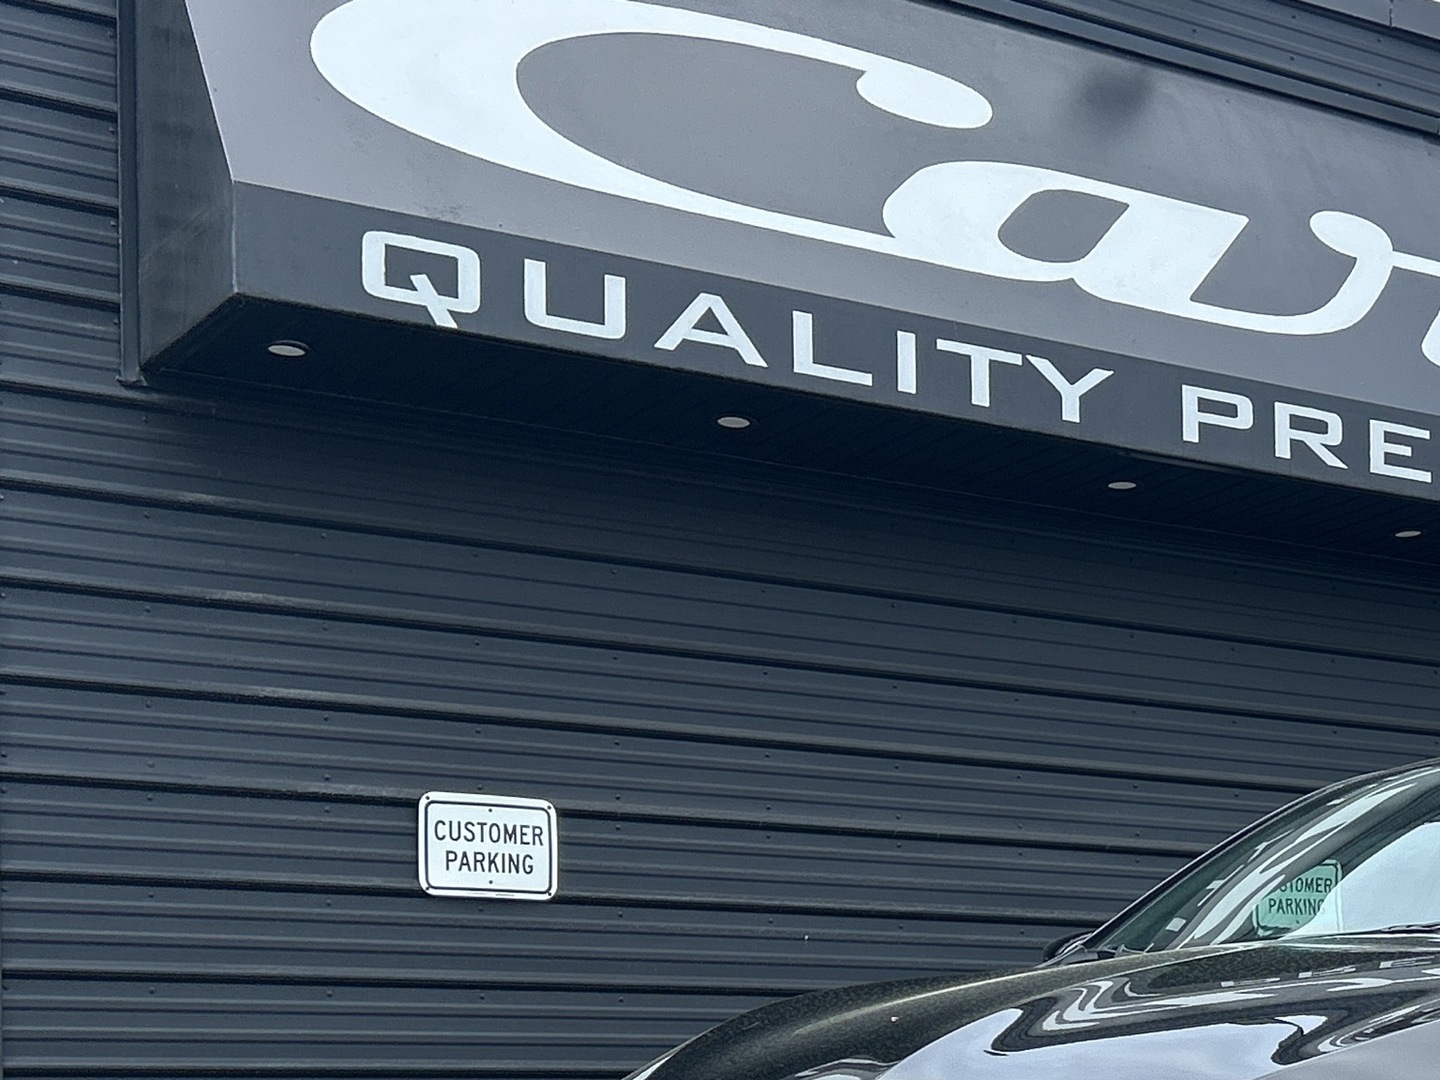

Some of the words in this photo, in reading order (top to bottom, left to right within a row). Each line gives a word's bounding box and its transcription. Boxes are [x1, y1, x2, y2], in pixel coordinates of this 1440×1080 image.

[361, 230, 1115, 423] QUALITY
[434, 819, 544, 846] CUSTOMER
[445, 850, 534, 875] PARKING
[1280, 877, 1333, 893] TOMER
